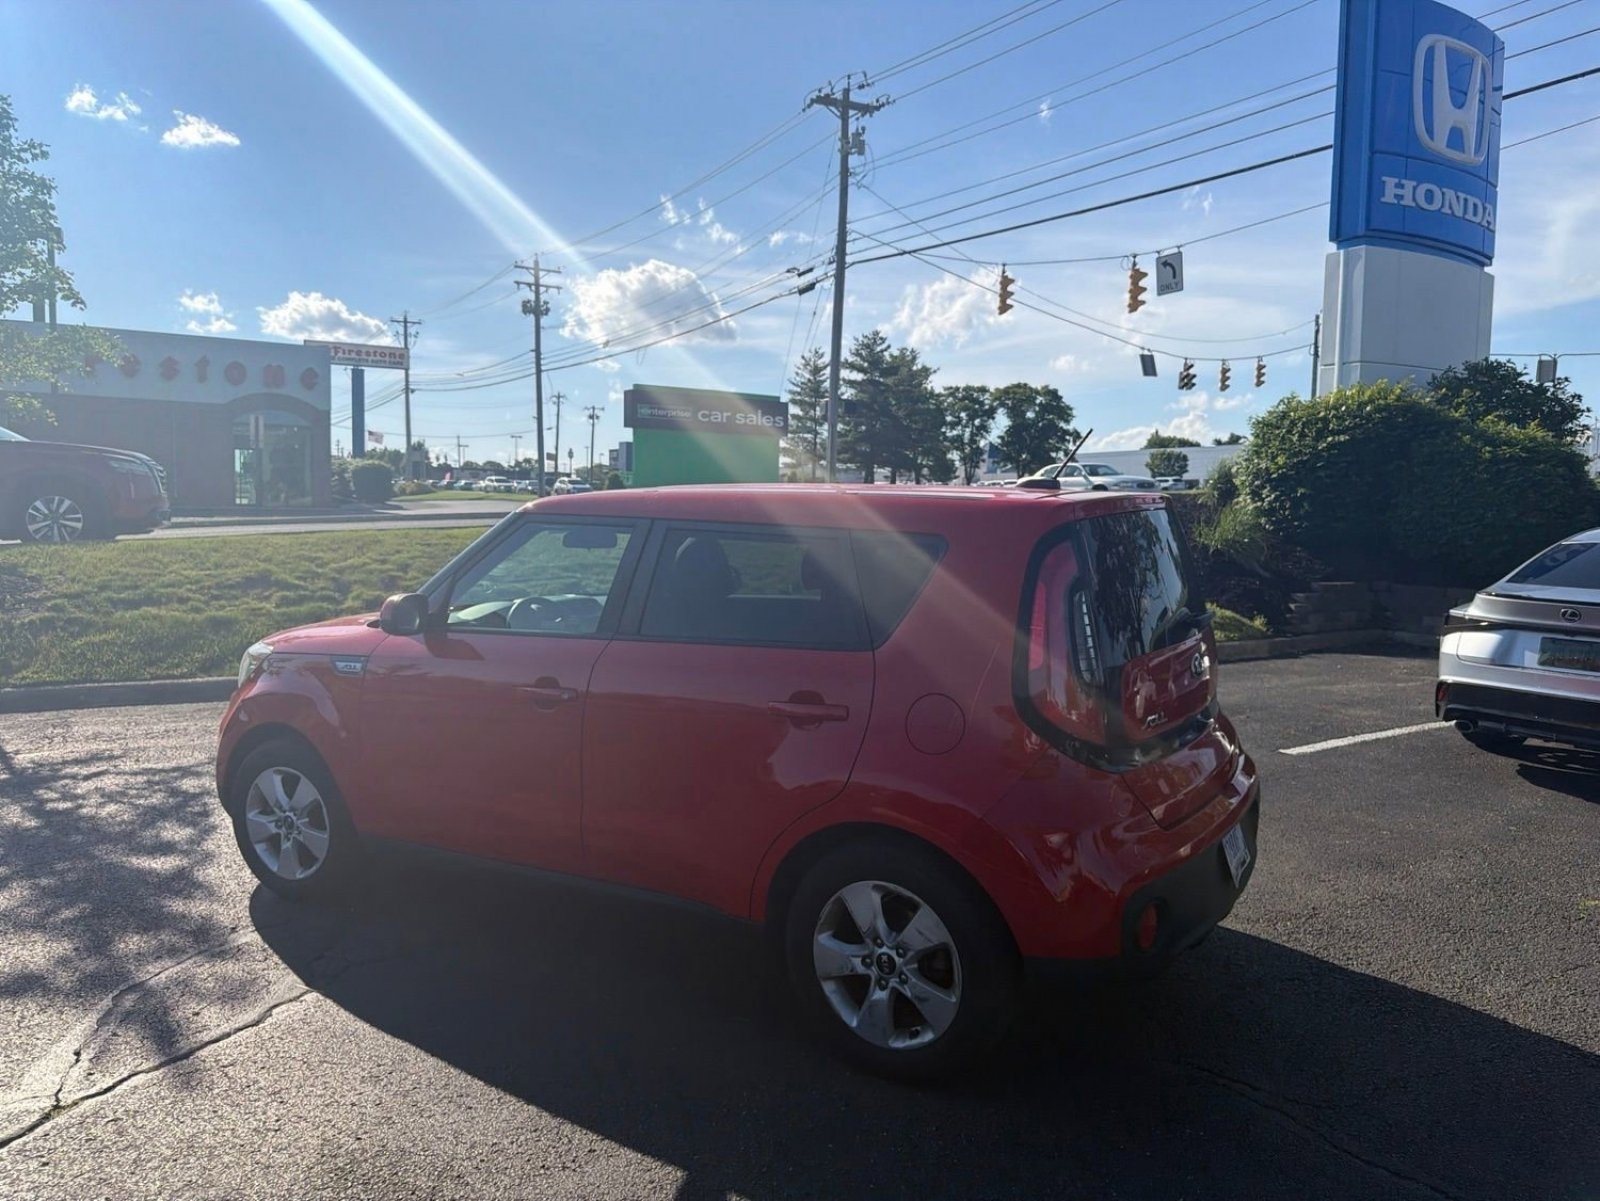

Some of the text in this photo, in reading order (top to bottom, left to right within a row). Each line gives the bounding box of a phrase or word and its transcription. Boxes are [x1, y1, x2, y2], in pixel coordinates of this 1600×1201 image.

[1380, 176, 1496, 231] HONDA
[1160, 281, 1180, 292] ONLY
[333, 345, 405, 360] Firestone
[697, 409, 731, 422] car
[735, 409, 784, 427] sales
